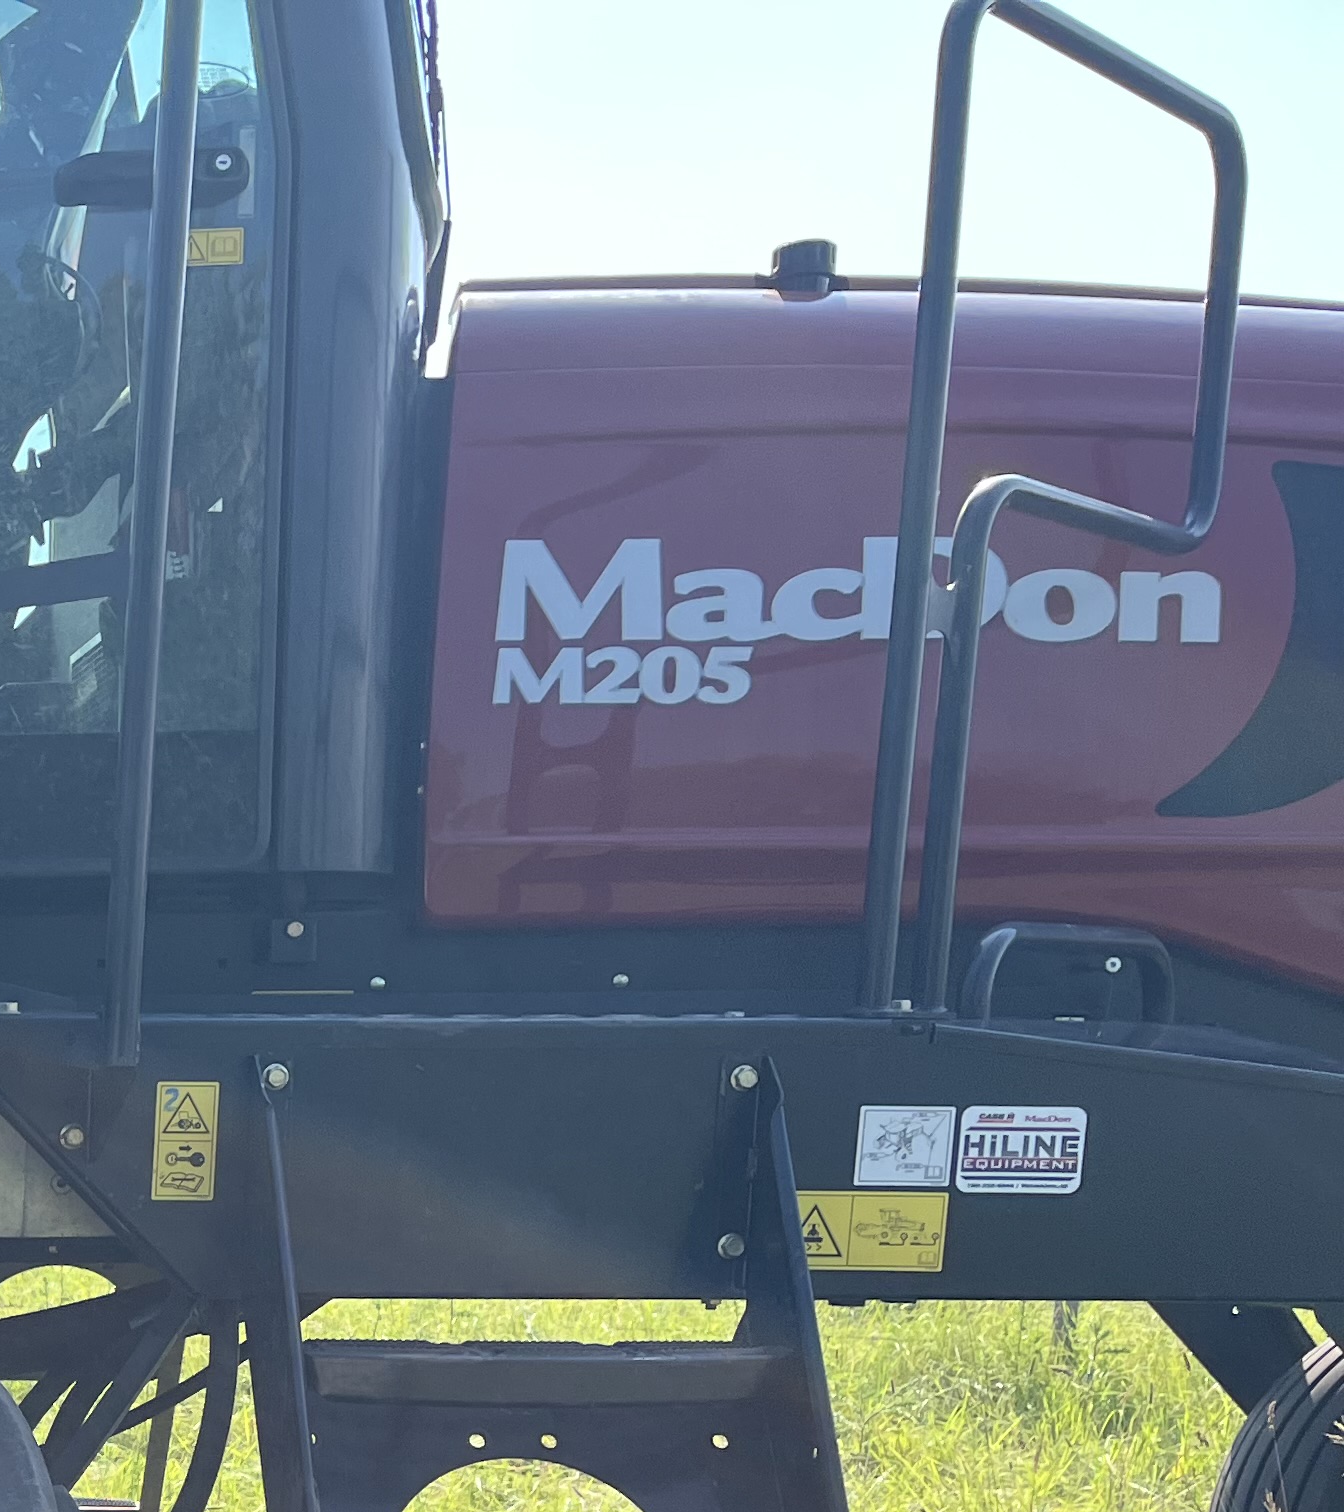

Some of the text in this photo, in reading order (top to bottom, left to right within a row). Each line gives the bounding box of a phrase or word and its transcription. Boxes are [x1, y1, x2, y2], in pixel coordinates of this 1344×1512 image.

[495, 538, 1221, 643] MacDon
[492, 646, 754, 704] M205
[963, 1158, 1077, 1171] EQUIPMENT
